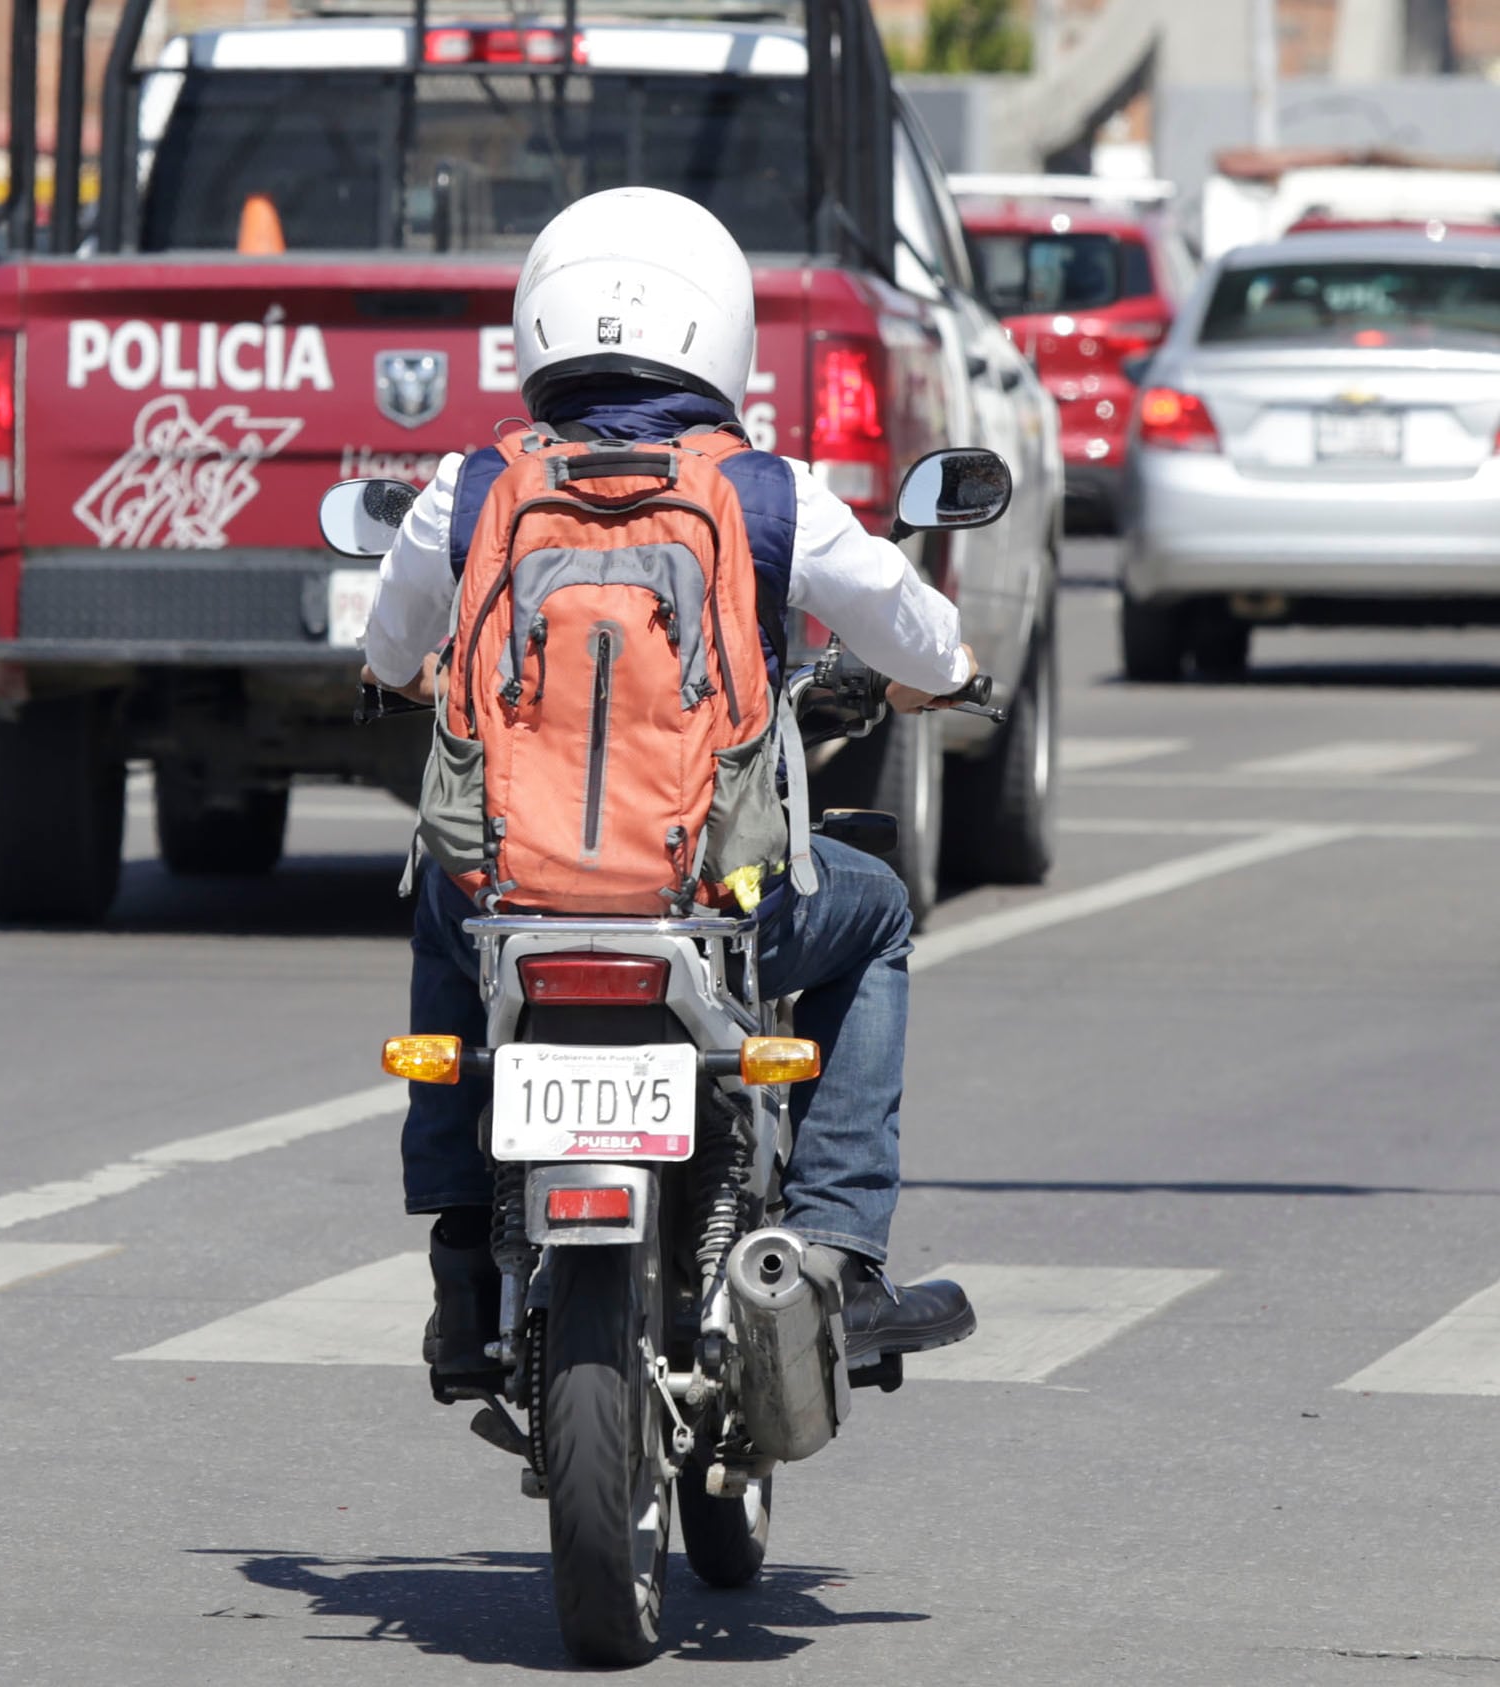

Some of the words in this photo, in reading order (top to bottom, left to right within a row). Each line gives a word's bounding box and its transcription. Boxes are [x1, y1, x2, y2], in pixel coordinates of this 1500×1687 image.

[600, 327, 620, 338] DOT
[67, 304, 333, 391] POLICÍA
[340, 444, 439, 481] Hace
[512, 1058, 523, 1070] T
[551, 1053, 593, 1062] Gobierno
[609, 1054, 640, 1062] Puebla
[522, 1078, 671, 1125] 10TDY5
[578, 1136, 642, 1149] PUEBLA
